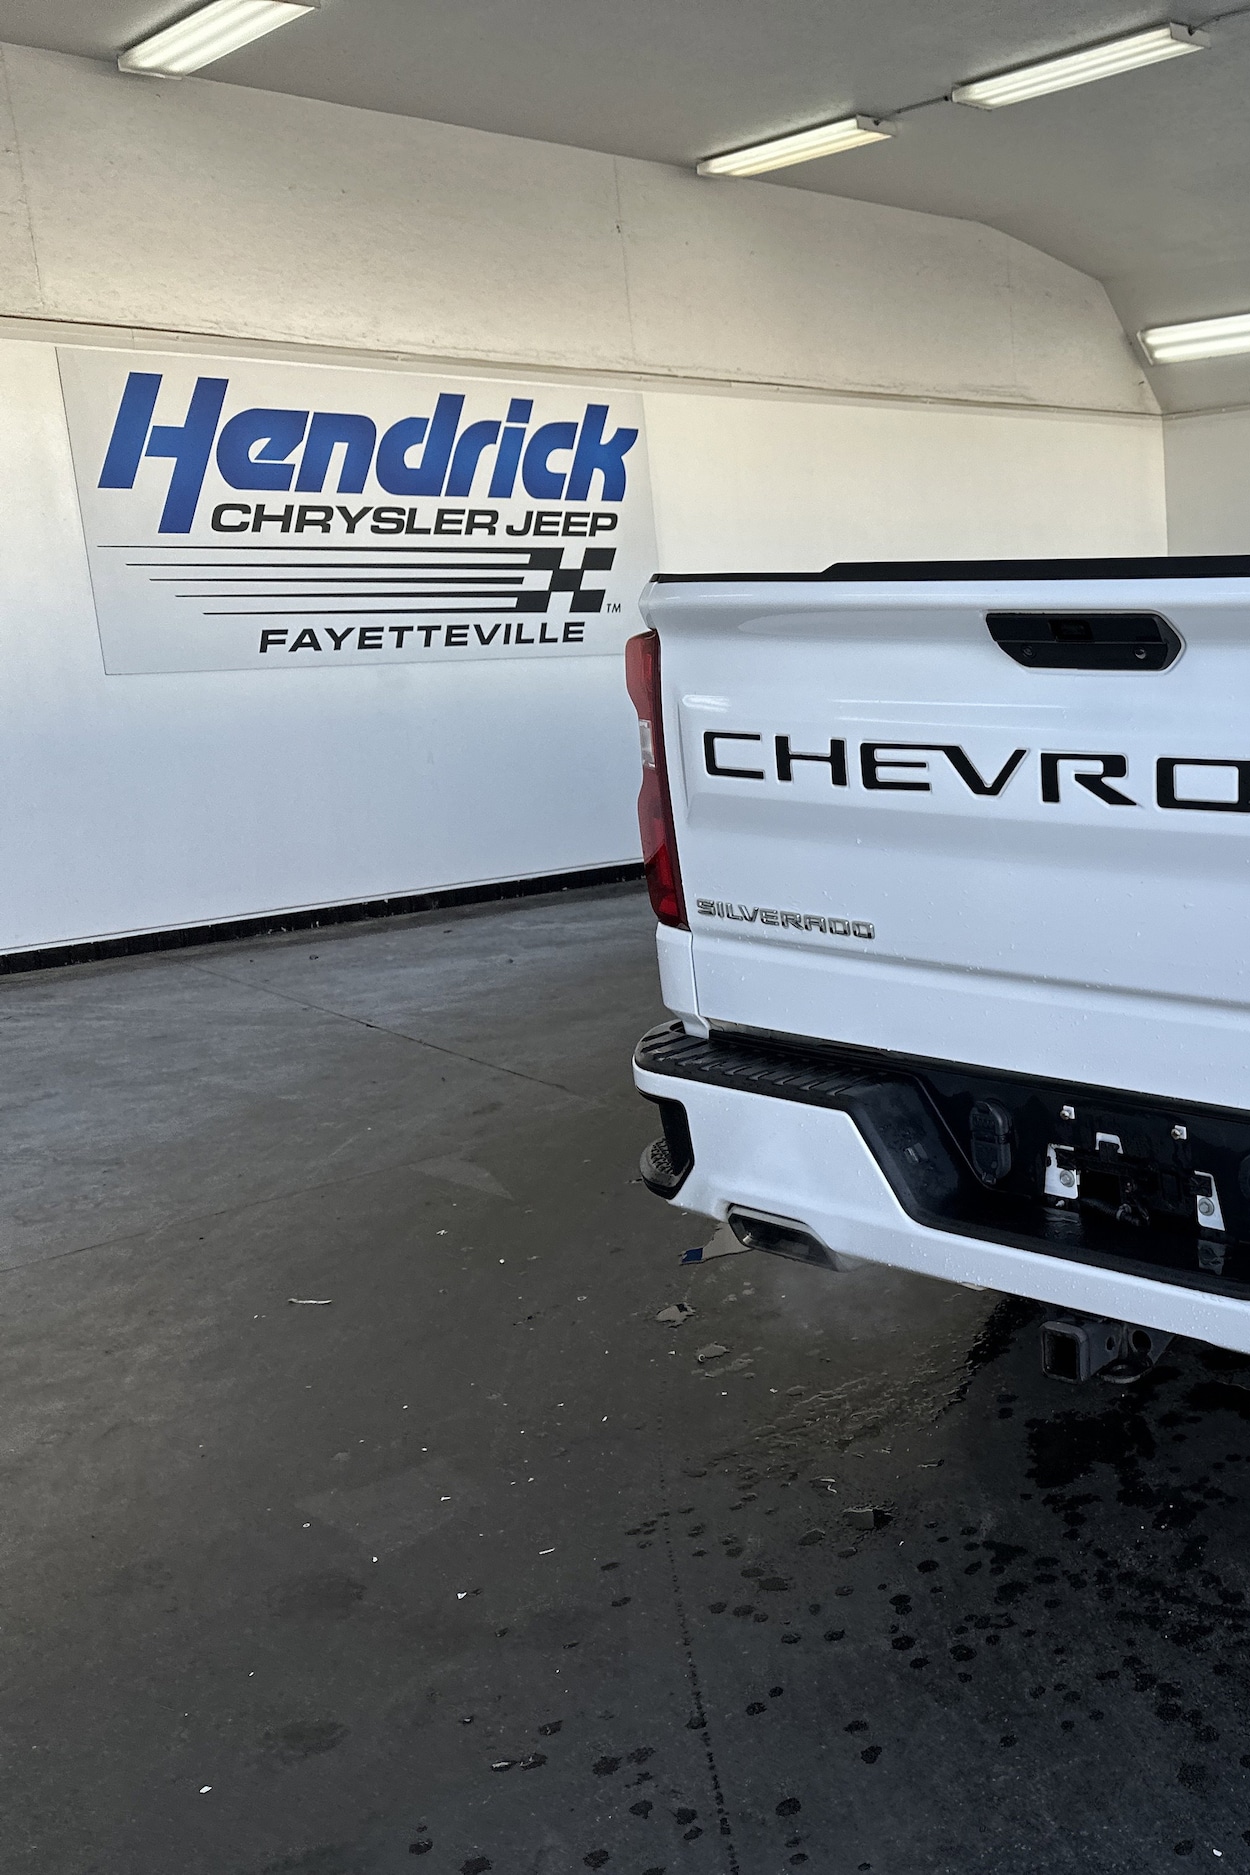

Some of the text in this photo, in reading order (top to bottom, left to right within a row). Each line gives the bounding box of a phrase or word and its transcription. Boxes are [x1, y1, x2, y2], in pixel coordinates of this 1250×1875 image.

[97, 371, 639, 534] Hendrick
[210, 502, 618, 538] CHRYSLER JEEP
[606, 603, 621, 613] TM
[259, 621, 585, 654] FAYETTEVILLE
[697, 898, 875, 940] SILVERADO
